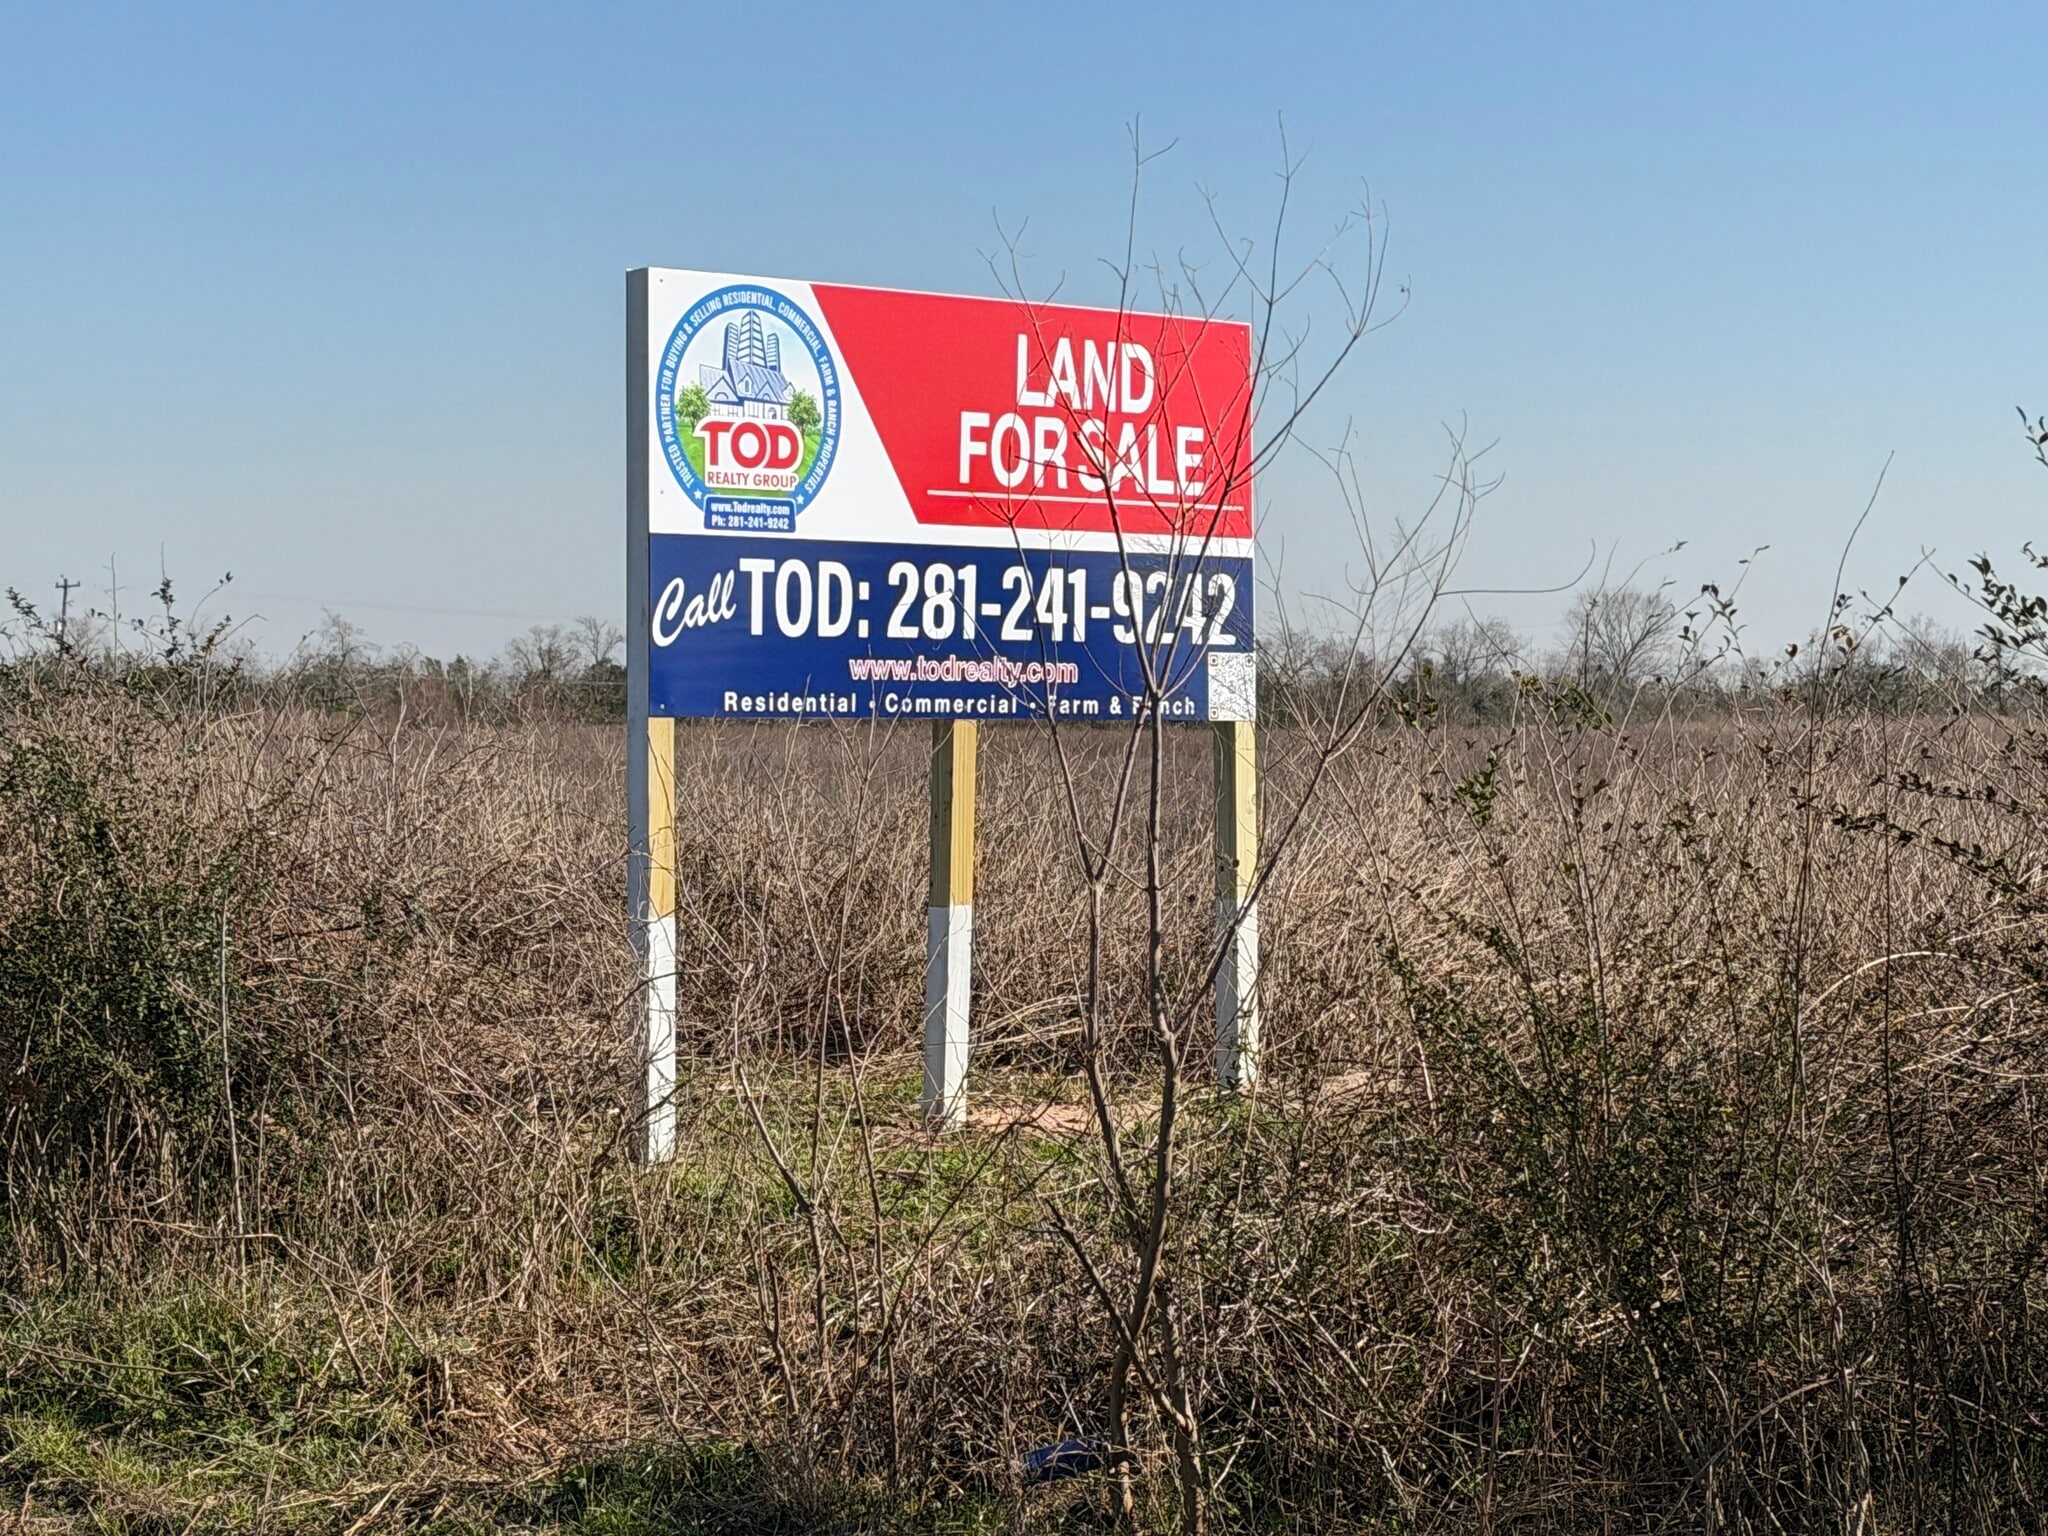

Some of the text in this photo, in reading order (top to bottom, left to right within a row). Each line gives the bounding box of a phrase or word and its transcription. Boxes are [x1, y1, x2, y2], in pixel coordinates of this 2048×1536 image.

[691, 296, 722, 327] SELLING
[723, 291, 776, 310] RESIDENTIAL,
[778, 301, 823, 357] COMMERCIAL,
[666, 331, 688, 368] BUYING
[661, 373, 674, 393] FOR
[819, 356, 833, 387] FARM
[1017, 334, 1154, 413] LAND
[660, 395, 674, 442] PARTNER
[829, 400, 838, 438] RANCH
[700, 421, 799, 469] TOD
[960, 412, 1205, 496] FOR SALE
[668, 444, 695, 489] TRUSTED
[707, 471, 797, 488] REALTY GROUP
[805, 439, 835, 494] PROPERTIES
[711, 501, 790, 517] www.Todrealty.com
[711, 515, 789, 530] Ph: 281-241-9242
[652, 558, 1237, 647] Call TOD: 281-241-9242
[849, 654, 1079, 687] www.todrealty.com
[724, 691, 856, 713] Residential
[885, 693, 1017, 714] Commercial
[1110, 696, 1122, 715] &
[1132, 696, 1195, 715] Rnch
